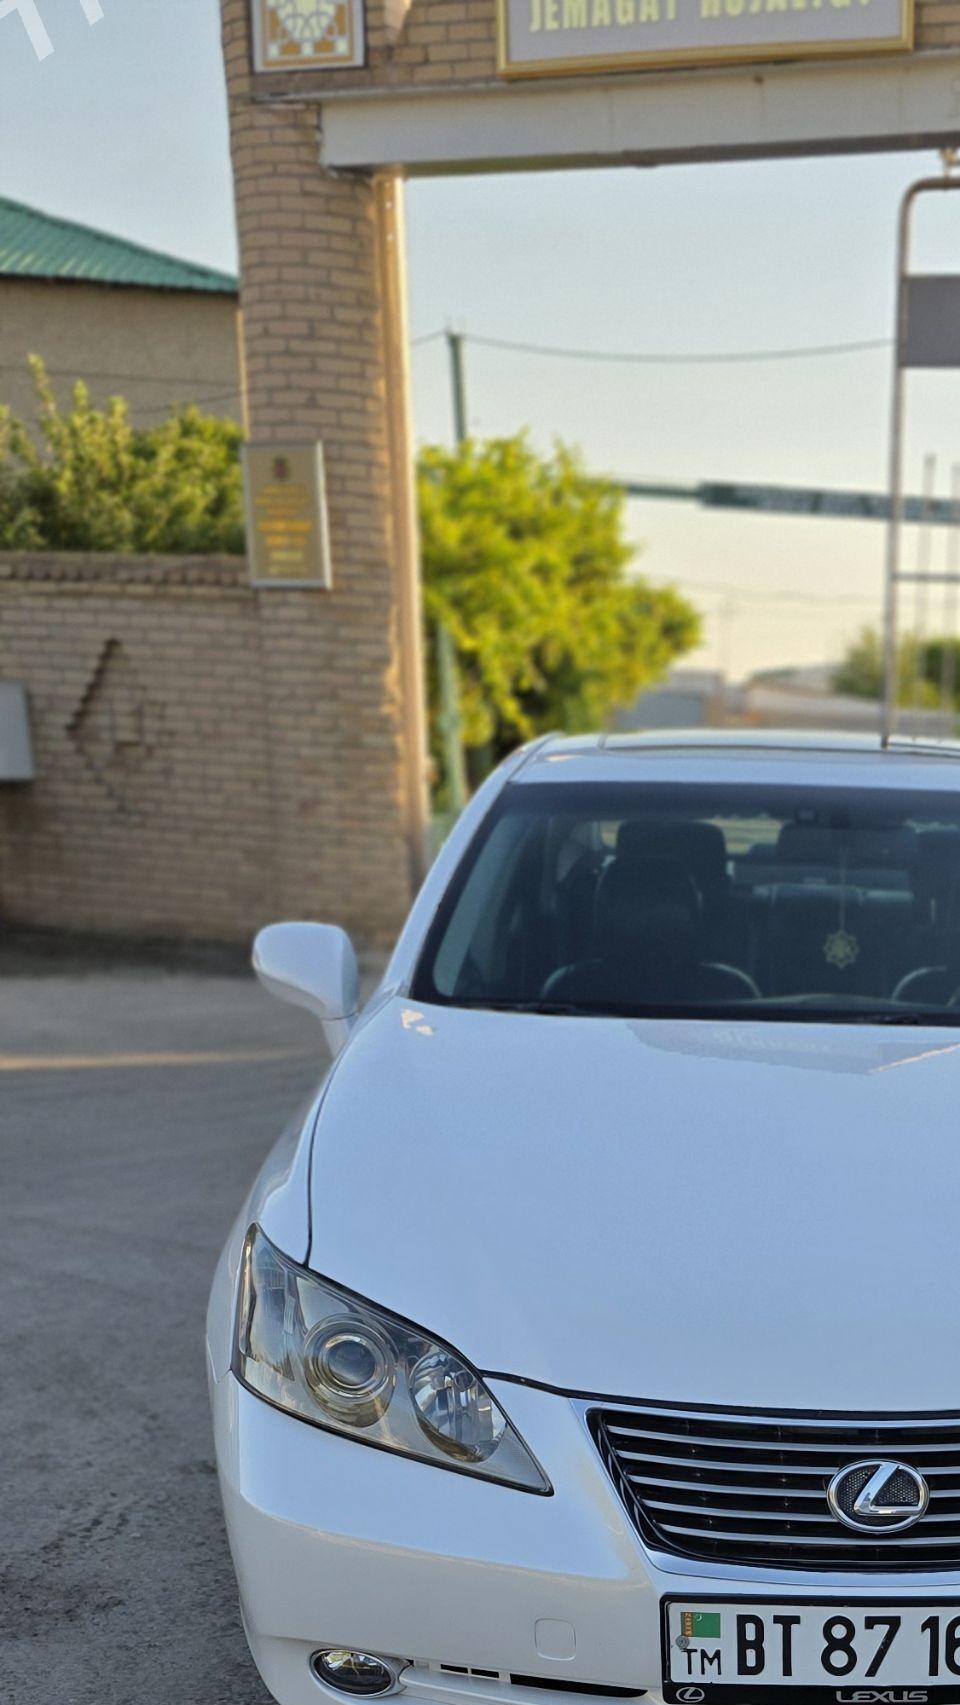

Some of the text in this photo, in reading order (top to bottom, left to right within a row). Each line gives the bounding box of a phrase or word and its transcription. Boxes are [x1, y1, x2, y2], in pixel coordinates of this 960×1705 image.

[736, 1613, 801, 1677] BT
[820, 1614, 901, 1678] 87
[681, 1648, 722, 1676] TM
[836, 1690, 929, 1704] LEXUS
